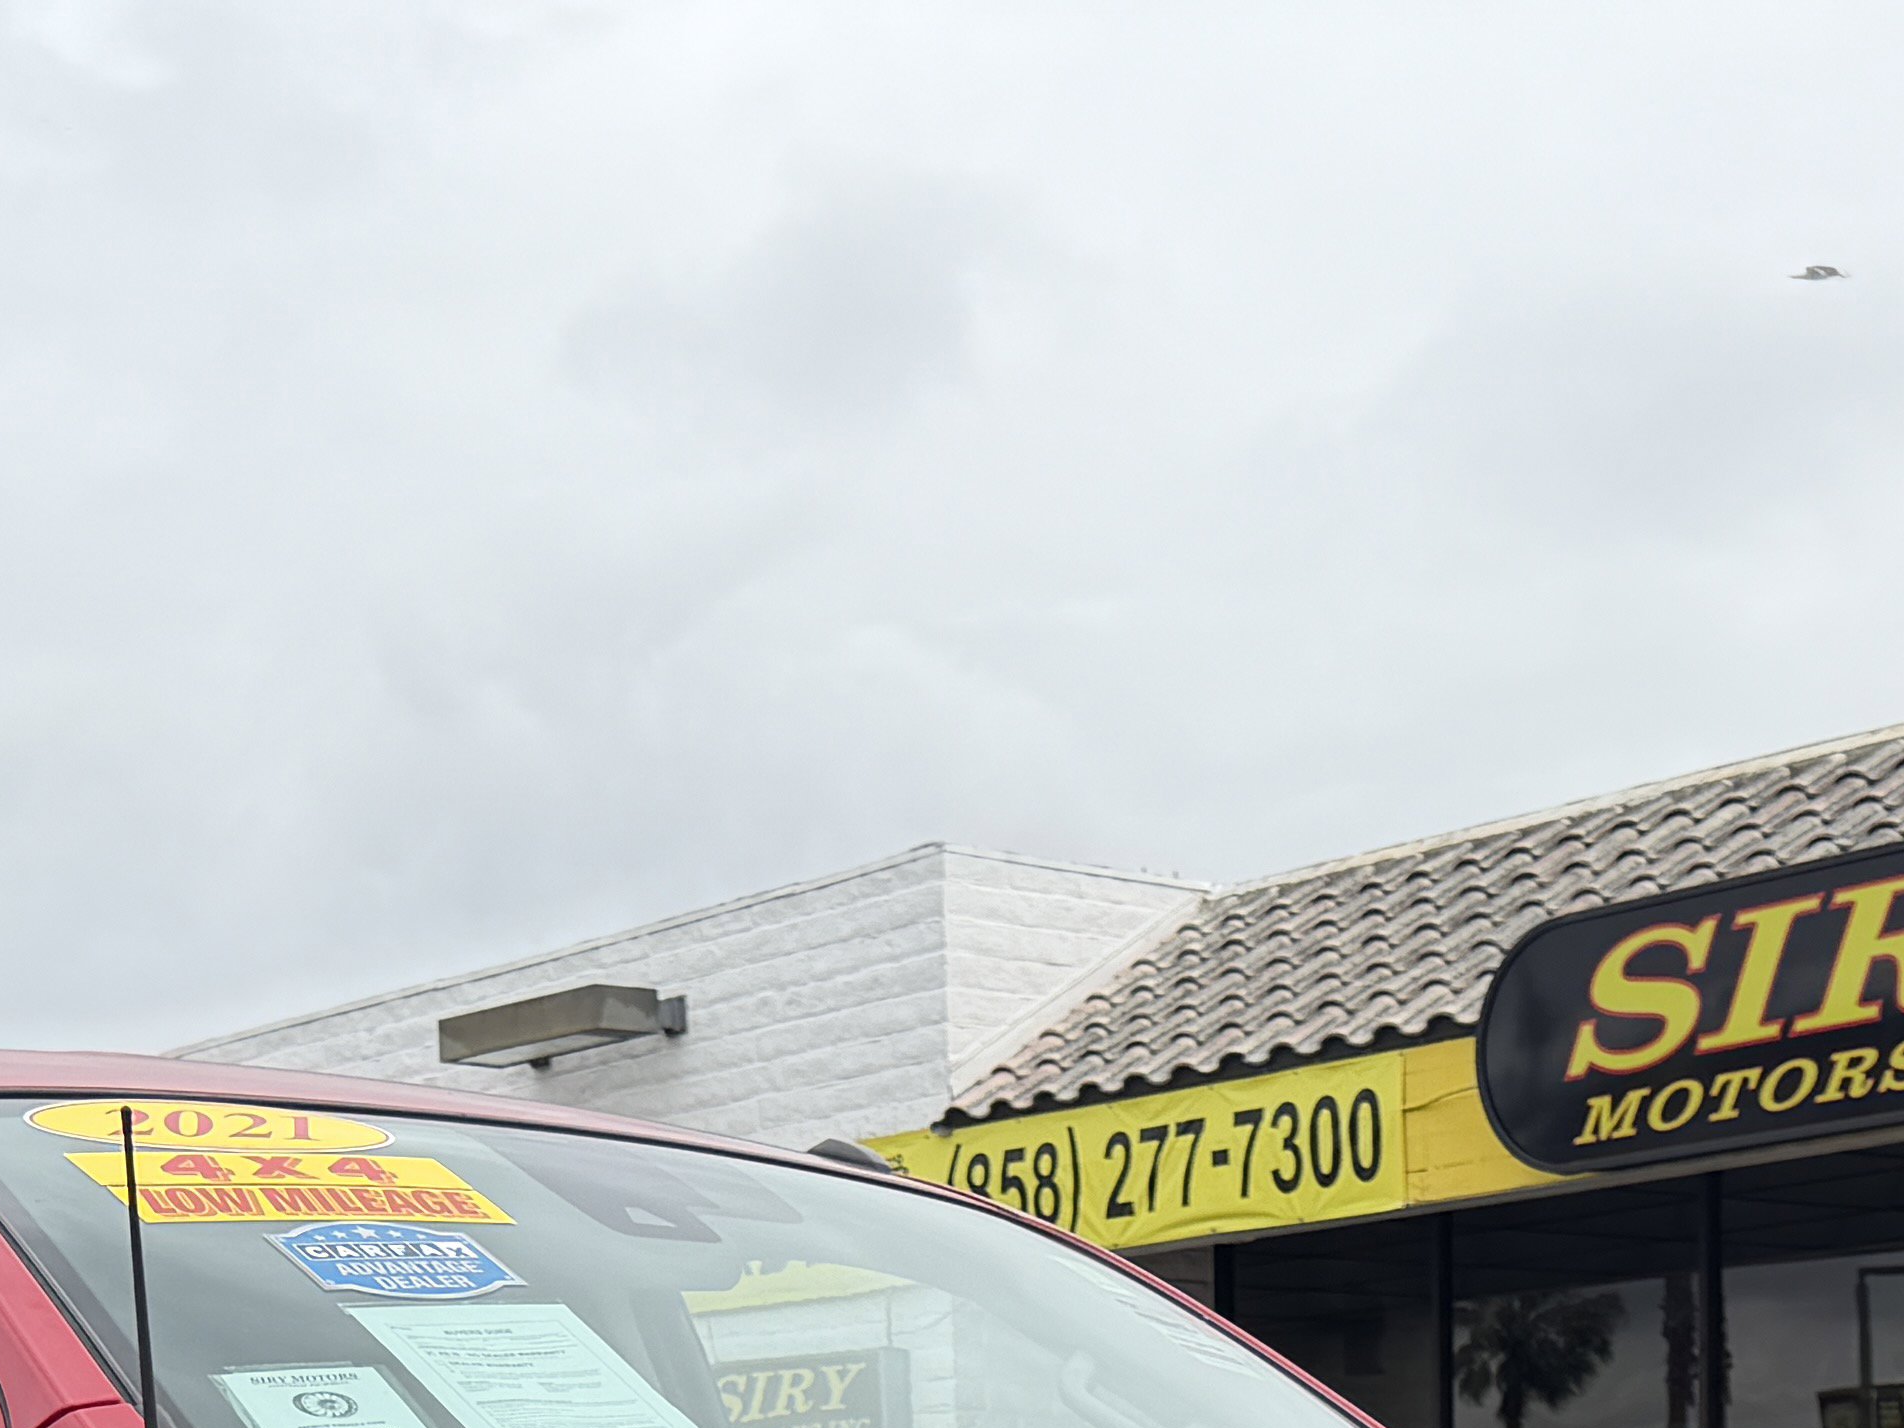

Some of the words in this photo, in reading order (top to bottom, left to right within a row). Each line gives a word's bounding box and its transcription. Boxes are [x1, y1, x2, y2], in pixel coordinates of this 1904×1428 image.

[105, 1109, 317, 1143] 2021
[1104, 1089, 1382, 1220] 277-7300
[139, 1187, 263, 1218] LOW
[267, 1188, 492, 1220] MILEAGE
[305, 1243, 480, 1260] CARFAX
[335, 1260, 484, 1276] ADVANTAGE
[373, 1273, 478, 1291] DEALER
[249, 1374, 288, 1386] SIRY
[290, 1372, 359, 1384] MOTORS
[718, 1362, 867, 1423] SIRY
